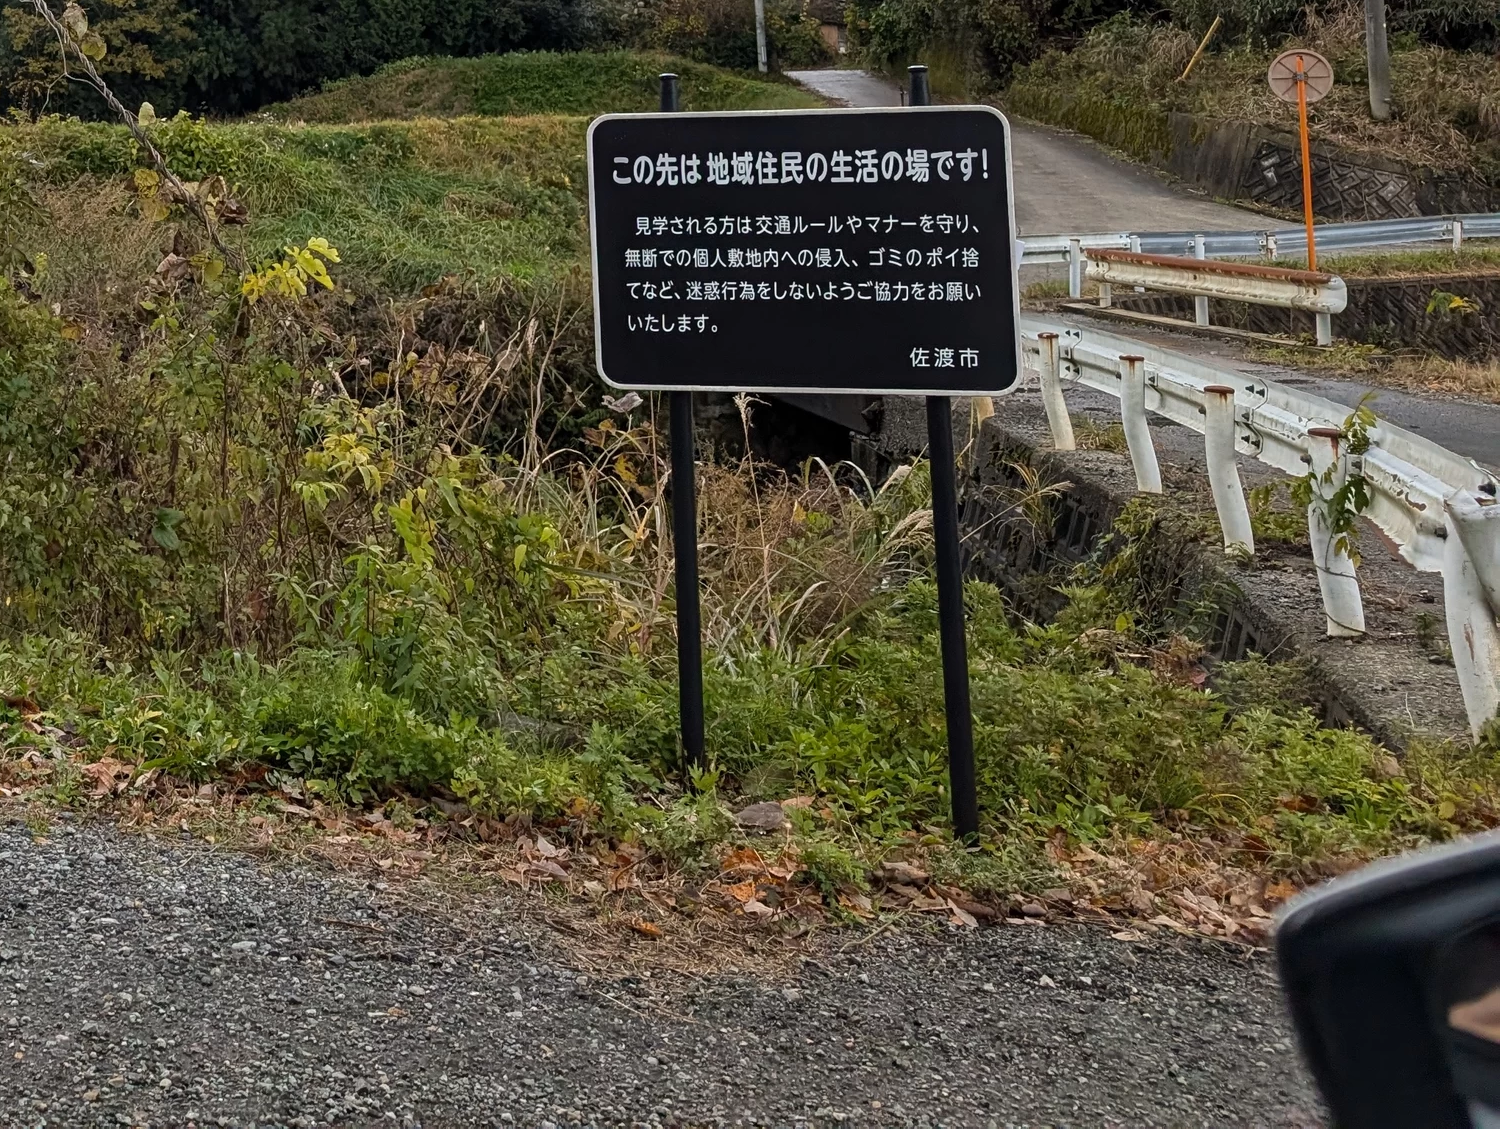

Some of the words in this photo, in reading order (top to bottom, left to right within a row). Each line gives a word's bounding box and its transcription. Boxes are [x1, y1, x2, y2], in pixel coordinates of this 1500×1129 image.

[612, 147, 989, 187] この先は地域住民の生活の場です!
[635, 213, 980, 236] 見学される方は交通ルールやマナーを守り、
[624, 246, 980, 268] 無断での個人敷地内への侵入、ゴミのポイ捨
[626, 280, 981, 302] てなど、迷惑行為をしないようご協力をお願い
[627, 313, 718, 334] いたします。
[909, 347, 980, 369] 佐渡市
